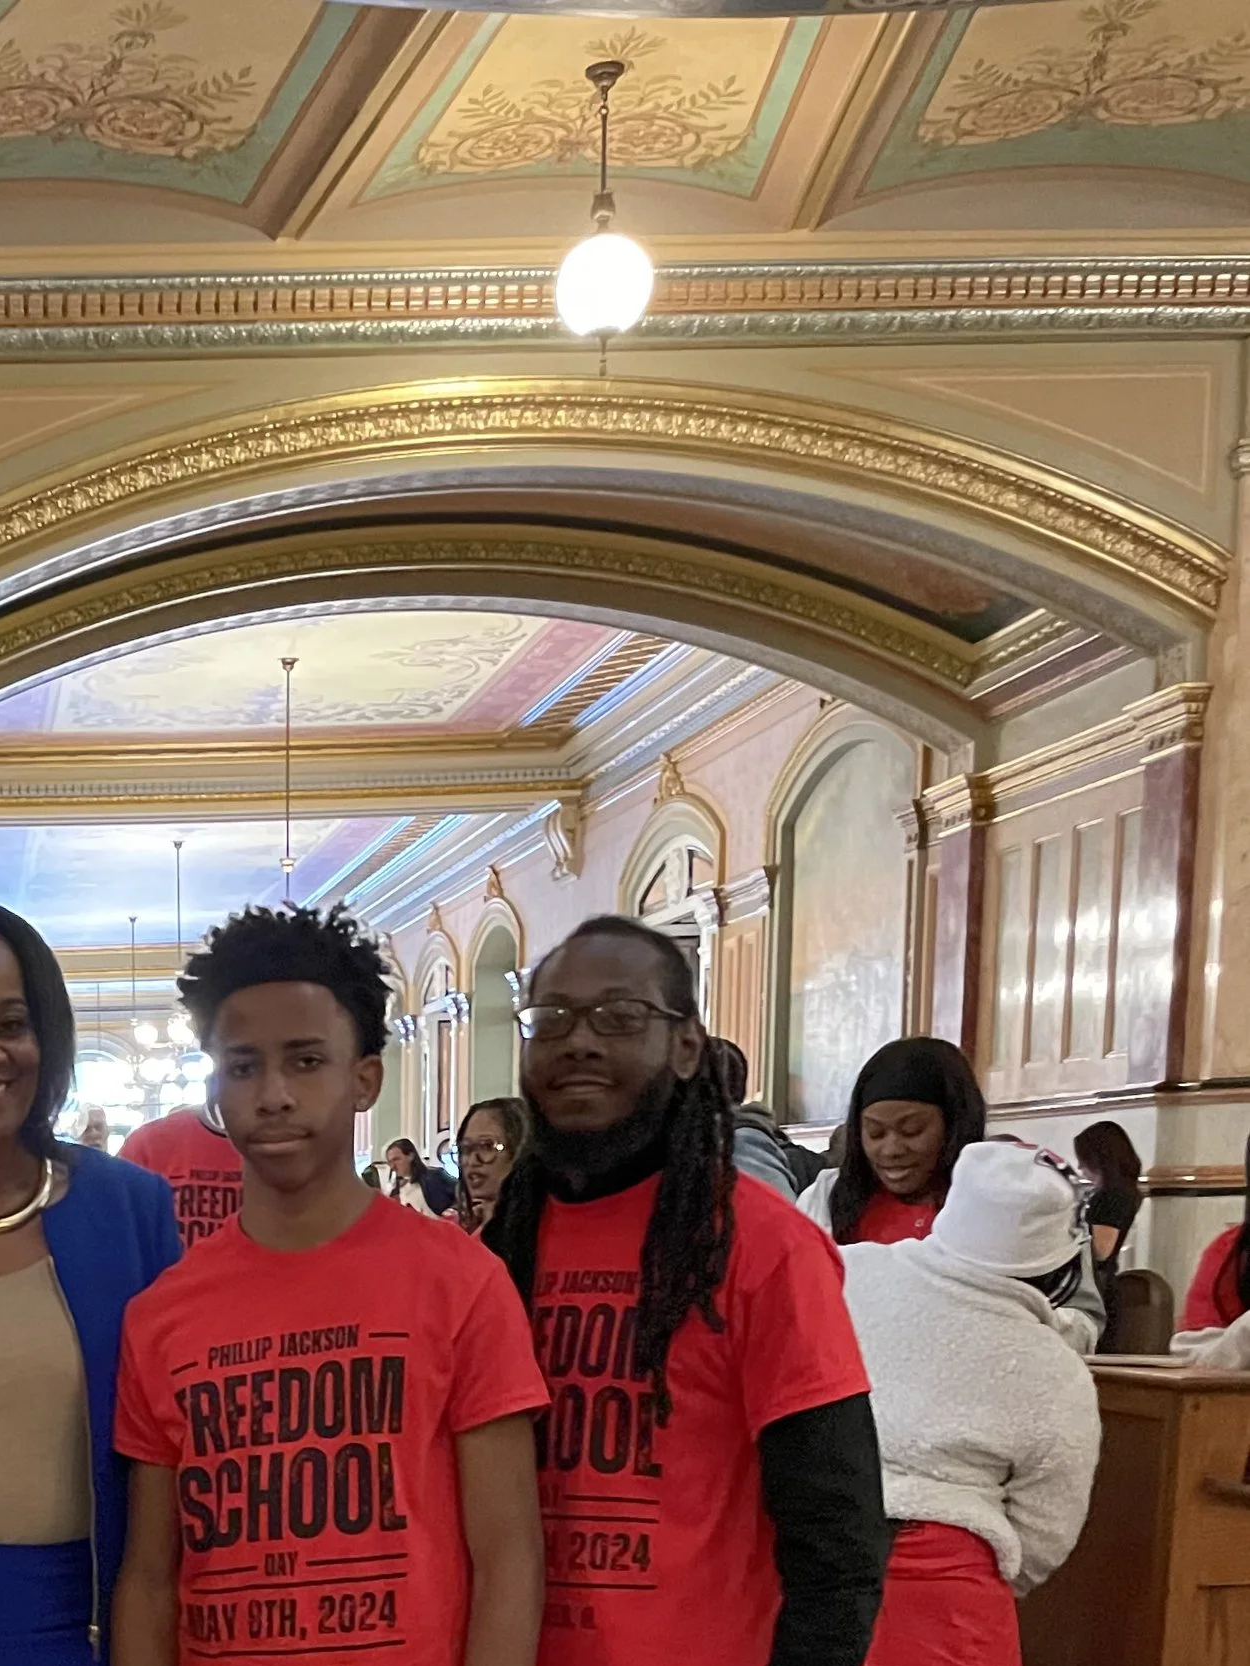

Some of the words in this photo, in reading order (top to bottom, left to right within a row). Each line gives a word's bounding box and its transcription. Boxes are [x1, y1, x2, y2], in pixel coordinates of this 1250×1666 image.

[171, 1185, 244, 1219] REED
[208, 1336, 273, 1369] PHILLIP
[278, 1323, 360, 1357] JACKSON
[179, 1442, 408, 1553] SCHOOL
[264, 1551, 299, 1577] DAY
[567, 1531, 652, 1573] 2024
[317, 1590, 398, 1635] 2024
